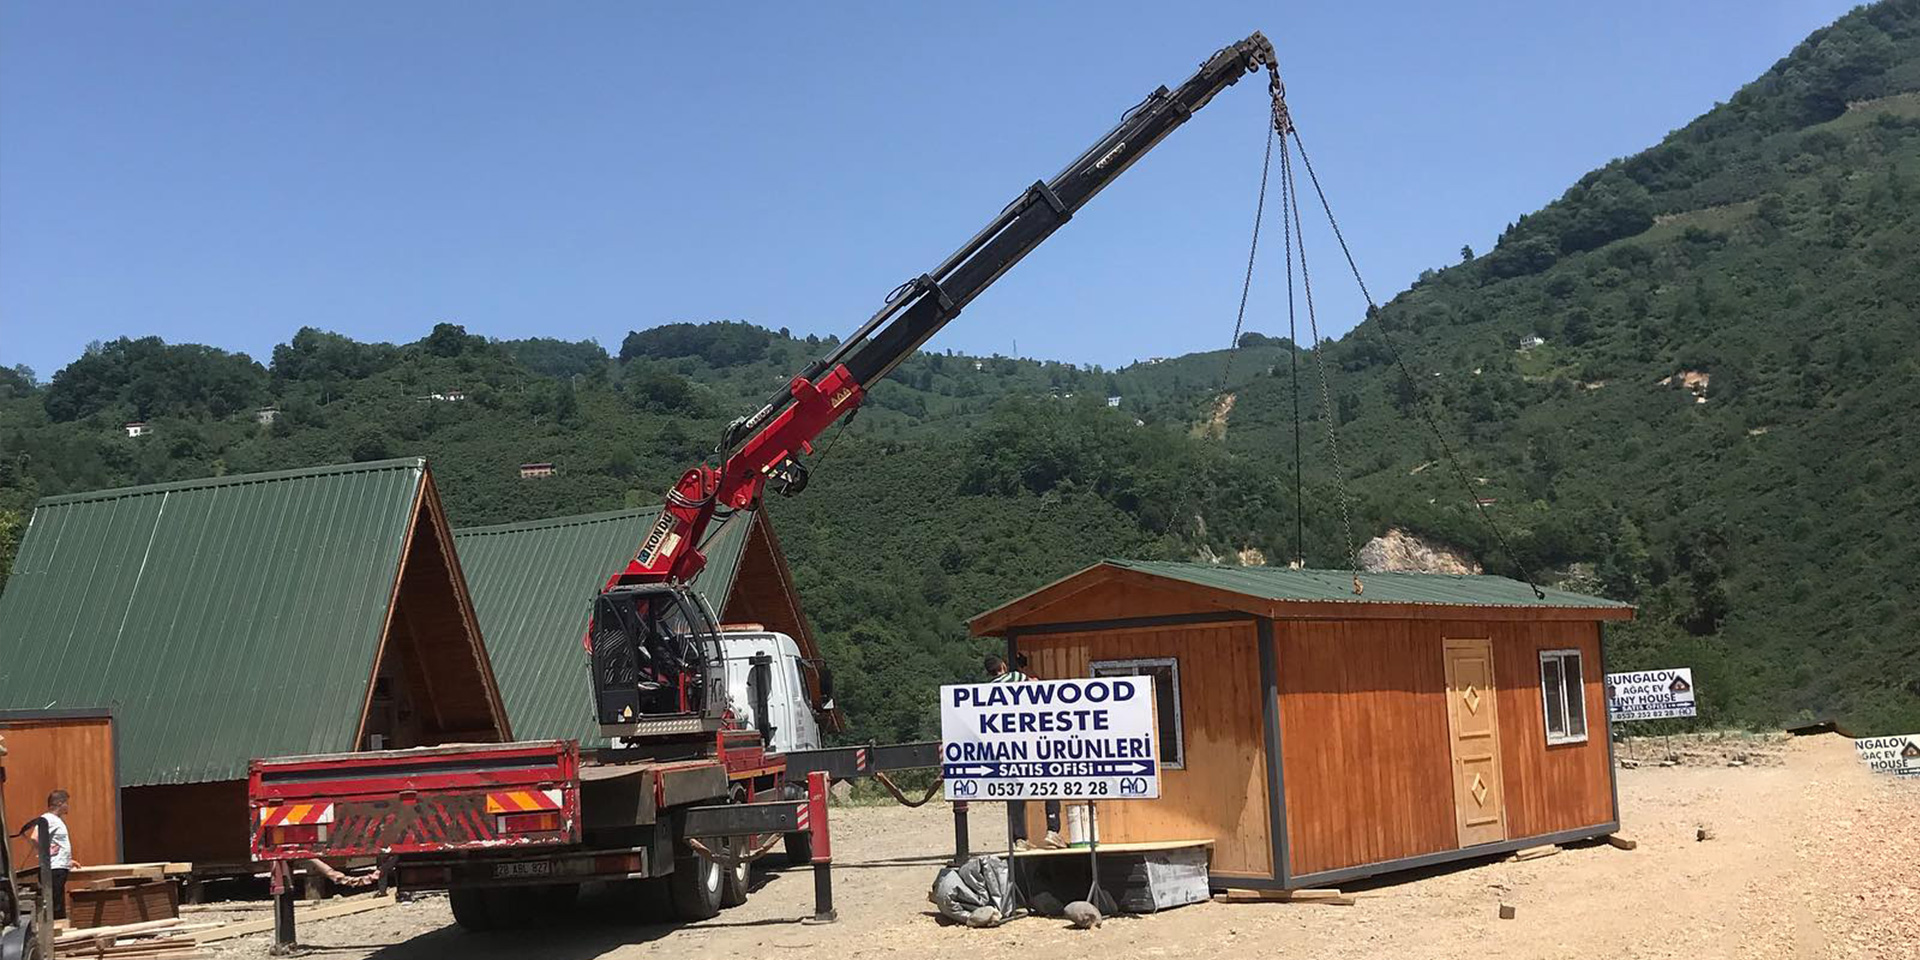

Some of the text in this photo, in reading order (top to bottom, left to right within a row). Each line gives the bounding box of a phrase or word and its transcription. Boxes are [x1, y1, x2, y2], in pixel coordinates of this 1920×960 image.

[644, 512, 673, 553] KONDU
[1607, 671, 1675, 686] BUNGALOV
[953, 681, 1135, 708] PLAYWOOD
[1653, 684, 1664, 692] EV
[1610, 693, 1676, 706] TINY HOUSE
[980, 710, 1109, 734] KERESTE
[946, 733, 1151, 762] ORMAN ÜRÜNLERİ
[1884, 750, 1896, 758] EV
[1871, 759, 1908, 770] HOUSE
[987, 782, 1024, 796] 0537
[1030, 782, 1058, 796] 252
[1063, 781, 1083, 796] 82
[1088, 781, 1108, 796] 28
